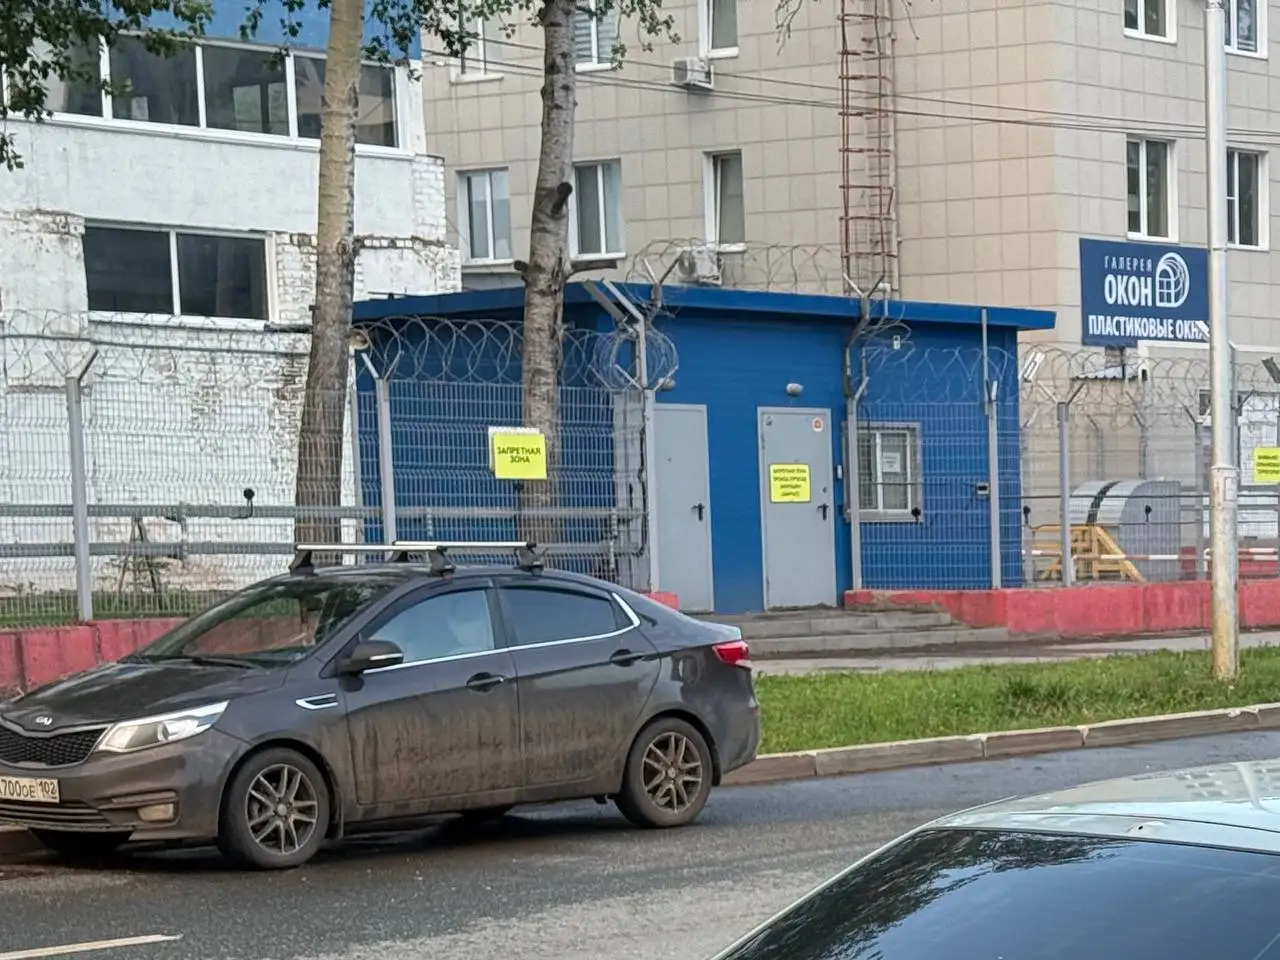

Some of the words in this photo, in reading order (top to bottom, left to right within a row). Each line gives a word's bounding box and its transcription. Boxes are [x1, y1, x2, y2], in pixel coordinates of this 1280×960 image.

[1104, 255, 1153, 272] ГАЛЕРЕЯ
[1104, 273, 1153, 307] ОКОН
[1088, 315, 1174, 339] ПЛАСТИКОВЫЕ
[1175, 319, 1208, 340] ОКН
[0, 780, 36, 798] 700ОЕ
[39, 781, 57, 797] 102
